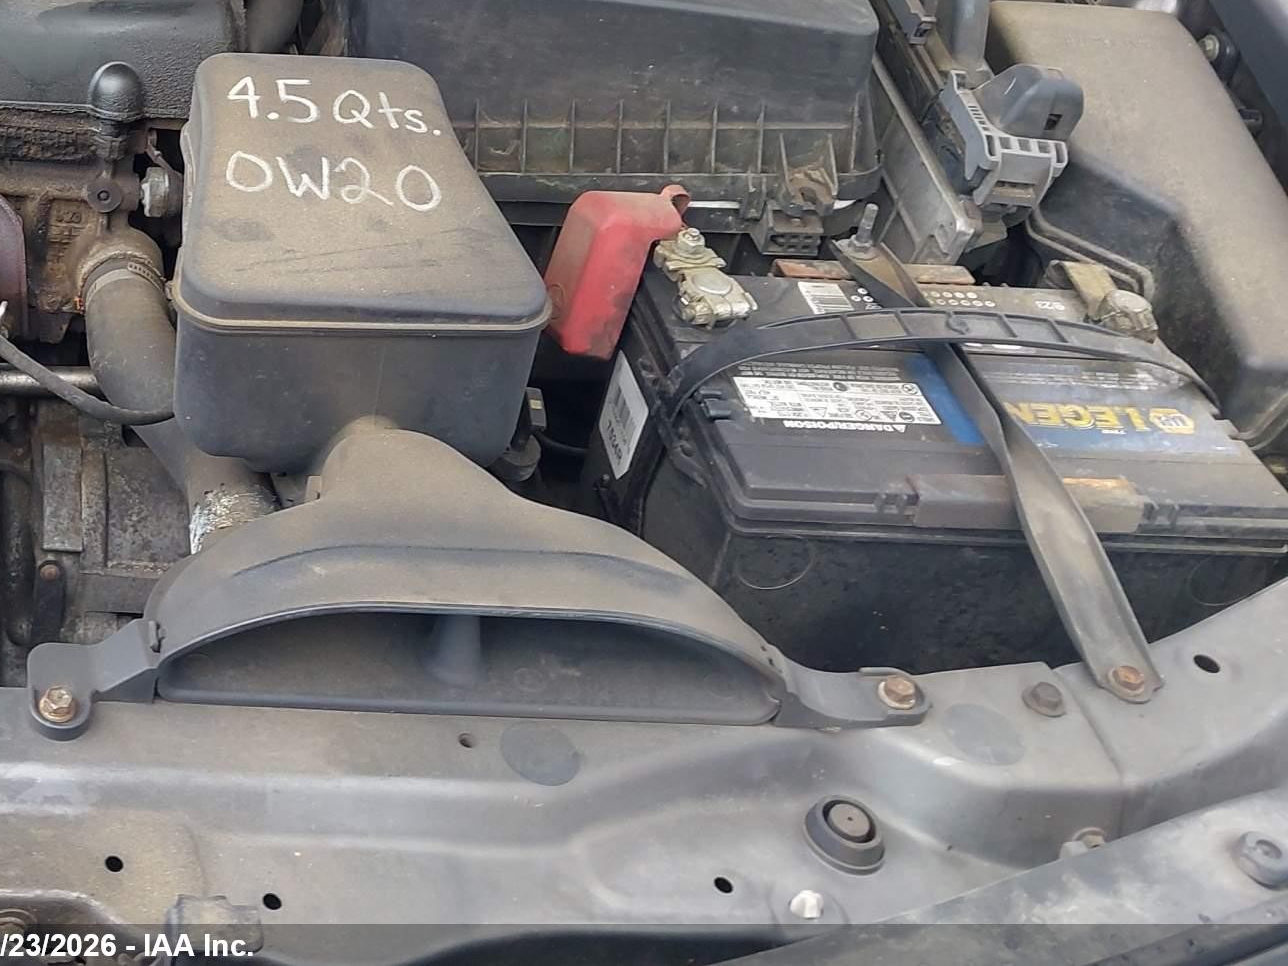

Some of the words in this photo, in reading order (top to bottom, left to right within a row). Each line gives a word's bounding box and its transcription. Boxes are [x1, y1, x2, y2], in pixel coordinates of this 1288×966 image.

[226, 76, 320, 124] 4.5
[332, 89, 442, 136] Qts.
[1003, 402, 1153, 432] LEGEN
